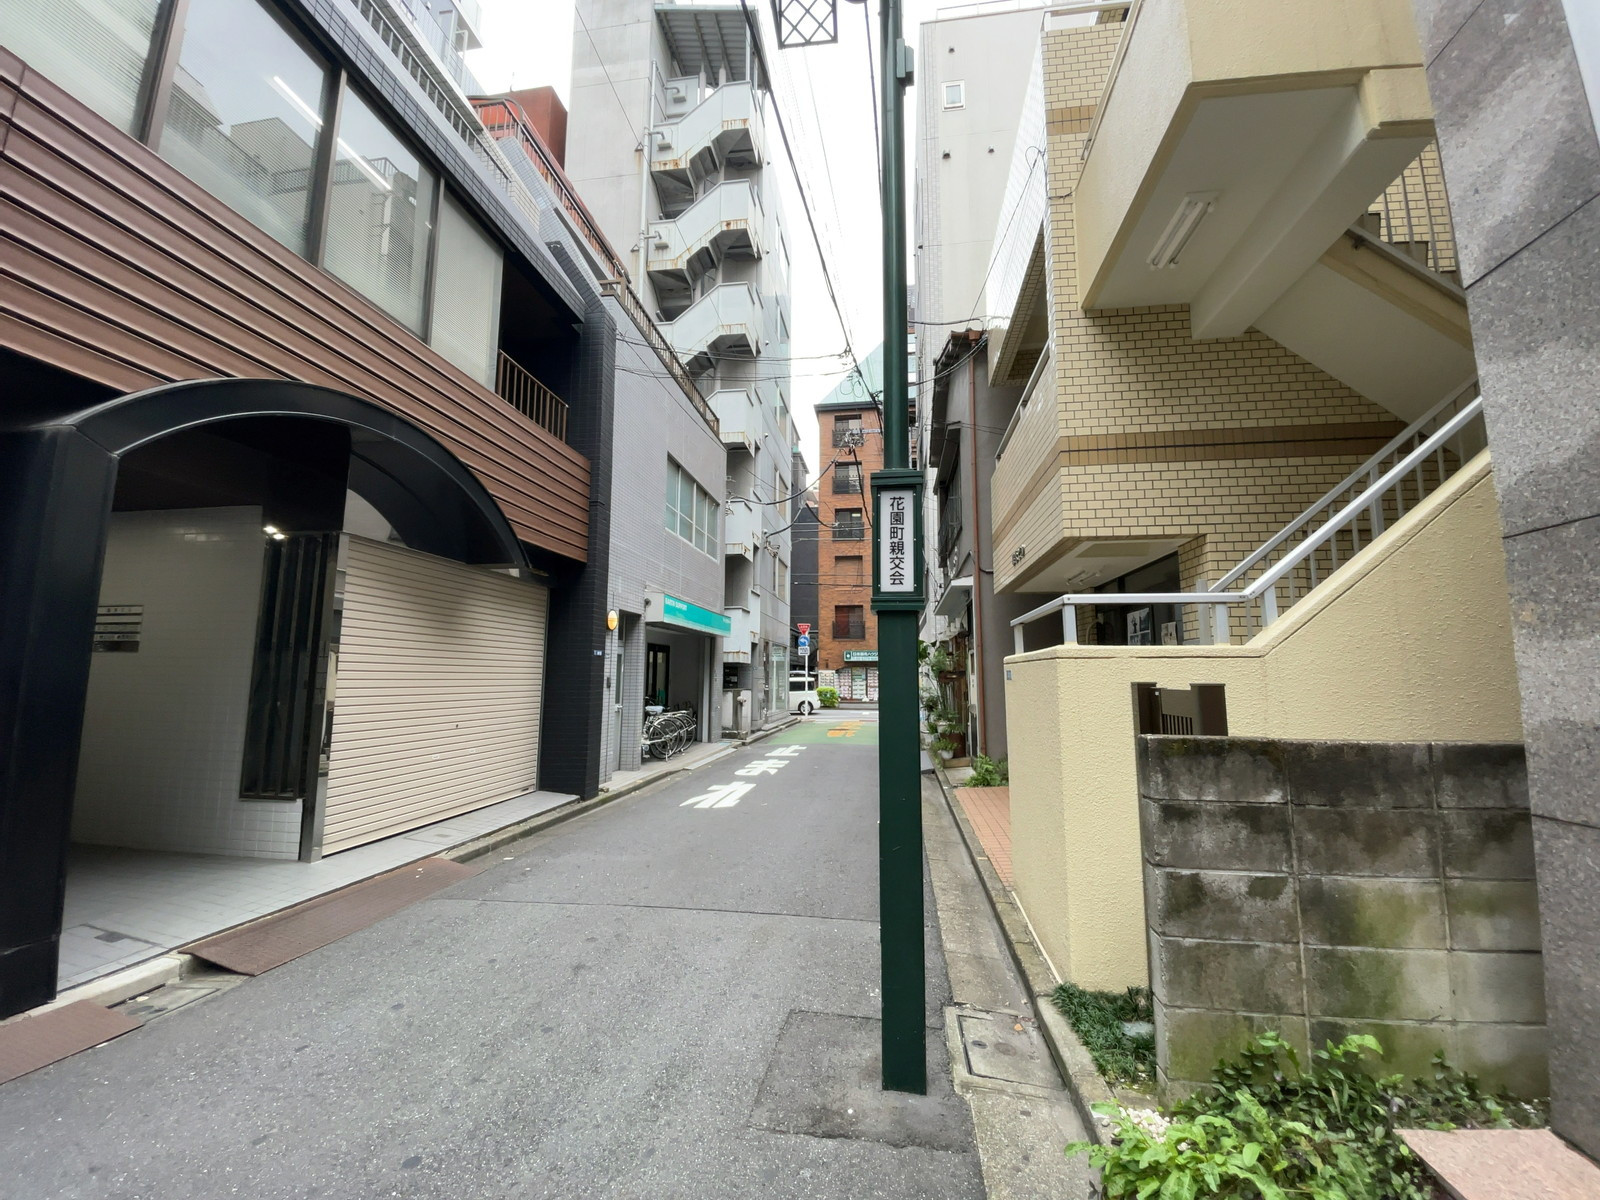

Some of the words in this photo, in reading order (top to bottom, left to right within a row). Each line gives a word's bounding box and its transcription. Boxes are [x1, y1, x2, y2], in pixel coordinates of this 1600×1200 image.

[889, 496, 905, 586] 花園町親交会
[679, 744, 807, 809] 止まれ
